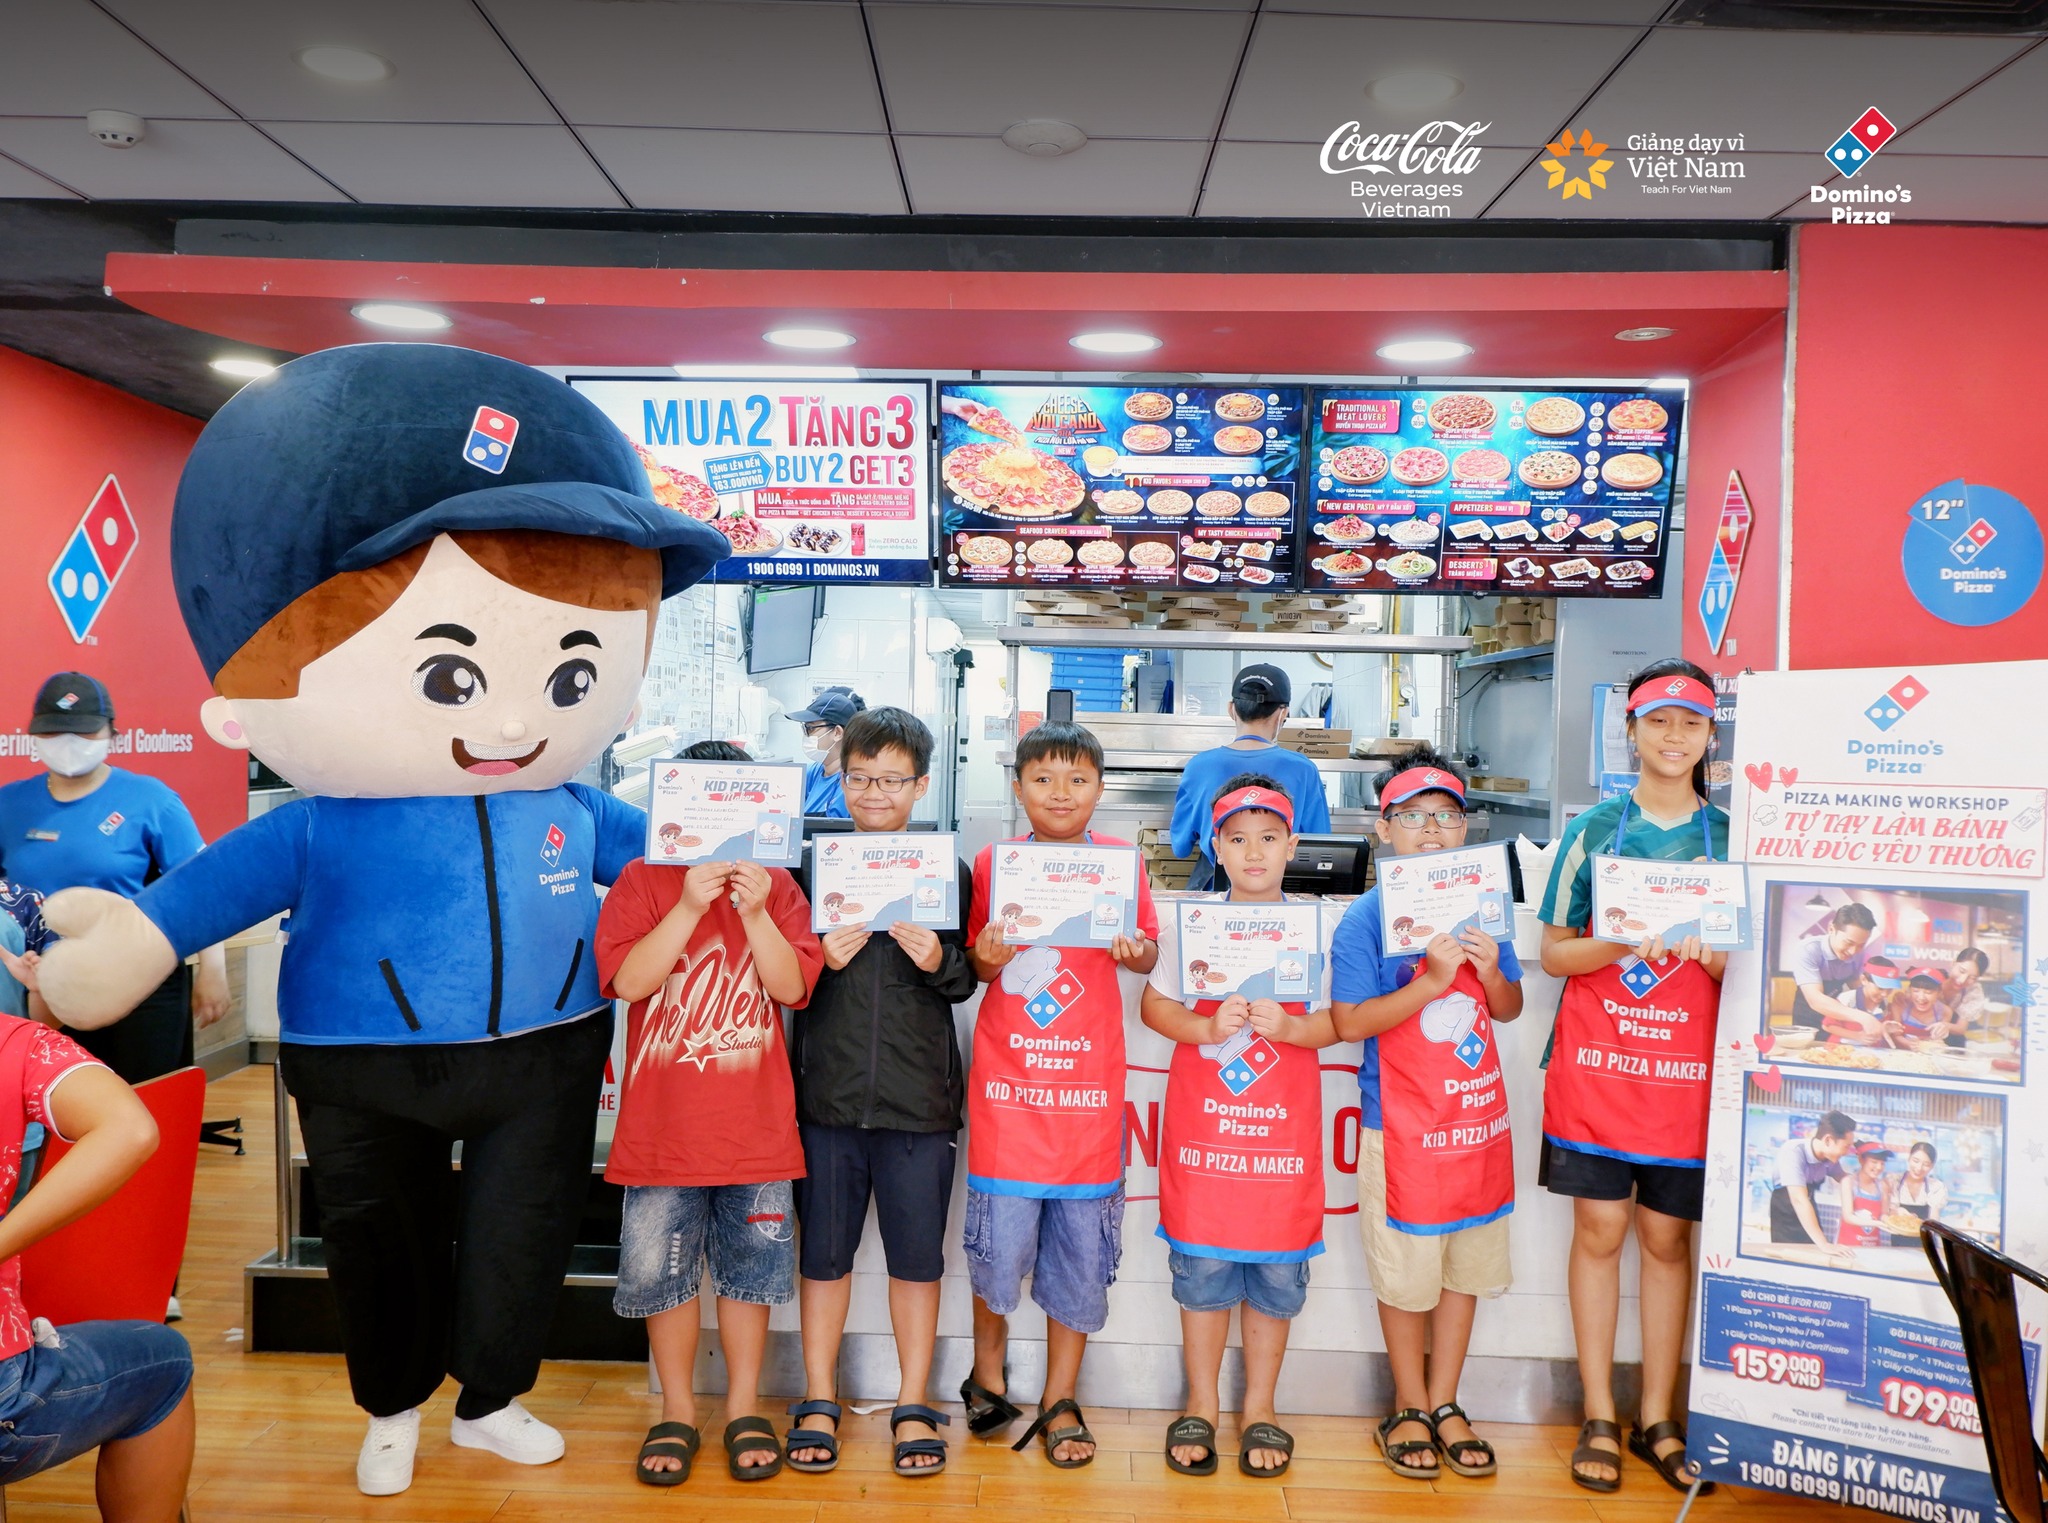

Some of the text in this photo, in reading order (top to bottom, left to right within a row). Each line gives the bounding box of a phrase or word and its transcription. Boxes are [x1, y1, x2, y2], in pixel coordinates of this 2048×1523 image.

[1043, 397, 1087, 414] CHEESE
[1337, 404, 1387, 412] TRADITIONAL &
[1032, 412, 1097, 428] VOLCANO
[1337, 413, 1387, 421] MEAT LOVERS
[730, 460, 743, 470] LÊN
[758, 493, 781, 504] MUA
[831, 492, 855, 507] TẶNG
[1454, 504, 1493, 512] APPETIZERS
[1020, 527, 1043, 535] SEAFOOD
[1198, 529, 1207, 537] MY
[1208, 529, 1225, 537] TASTY
[748, 563, 879, 576] 1900 6099 DOMINOS.VN
[1449, 561, 1483, 569] DESSERTS
[1940, 568, 2007, 582] Domino's
[1954, 581, 1994, 594] Pizza
[135, 729, 192, 753] Goodness
[1847, 740, 1944, 756] Domino's
[1866, 758, 1923, 774] Pizza
[704, 781, 769, 792] KID PIZZA
[1784, 792, 2009, 811] PIZZA MAKING WORKSHOP
[1785, 810, 2008, 839] TỰ TAY LÀM BÁNH
[862, 850, 923, 860] KID PIZZA
[1813, 837, 1866, 859] ĐÚC
[1872, 840, 1924, 864] YÊU
[1928, 842, 2036, 870] THƯƠNG
[539, 866, 579, 885] Domino's
[1043, 862, 1104, 874] KID PIZZA
[1428, 864, 1482, 881] KID PIZZA
[1645, 875, 1711, 887] KID PIZZA
[551, 884, 575, 896] Pizza
[1225, 921, 1286, 931] KID PIZZA
[1604, 999, 1689, 1023] Domino's
[1619, 1020, 1671, 1041] Pizza
[1010, 1033, 1092, 1052] Domino's
[1026, 1052, 1074, 1070] Pizza
[1577, 1047, 1706, 1081] KID PIZZA MAKER
[1444, 1065, 1500, 1094] Domino's
[986, 1081, 1108, 1108] KID PIZZA MAKER
[1462, 1089, 1496, 1108] Pizza
[1204, 1098, 1287, 1120] Domino's
[1219, 1118, 1269, 1137] Pizza
[1423, 1131, 1446, 1148] KID
[1452, 1125, 1488, 1145] PIZZA
[1179, 1147, 1304, 1175] KID PIZZA MAKER
[1741, 1290, 1832, 1310] GÓI CHO BÉ (FOR KID)
[1732, 1305, 1752, 1315] Pizza
[1754, 1322, 1768, 1330] Pin
[1769, 1324, 1784, 1333] huy
[1810, 1330, 1824, 1338] Pin
[1826, 1319, 1850, 1329] Drink
[1890, 1326, 1907, 1340] GÓI
[1908, 1332, 1921, 1343] BA
[1806, 1341, 1850, 1355] Certificate
[1789, 1371, 1820, 1388] VND
[1950, 1416, 1983, 1434] VND
[1801, 1420, 1826, 1430] contact
[1842, 1429, 1862, 1438] store
[1878, 1435, 1906, 1446] further
[1908, 1441, 1951, 1455] assistance.
[1772, 1438, 1946, 1499] ĐĂNG KÝ NGAY
[1739, 1461, 1980, 1523] 1900 6099 DOMINOS.VN
